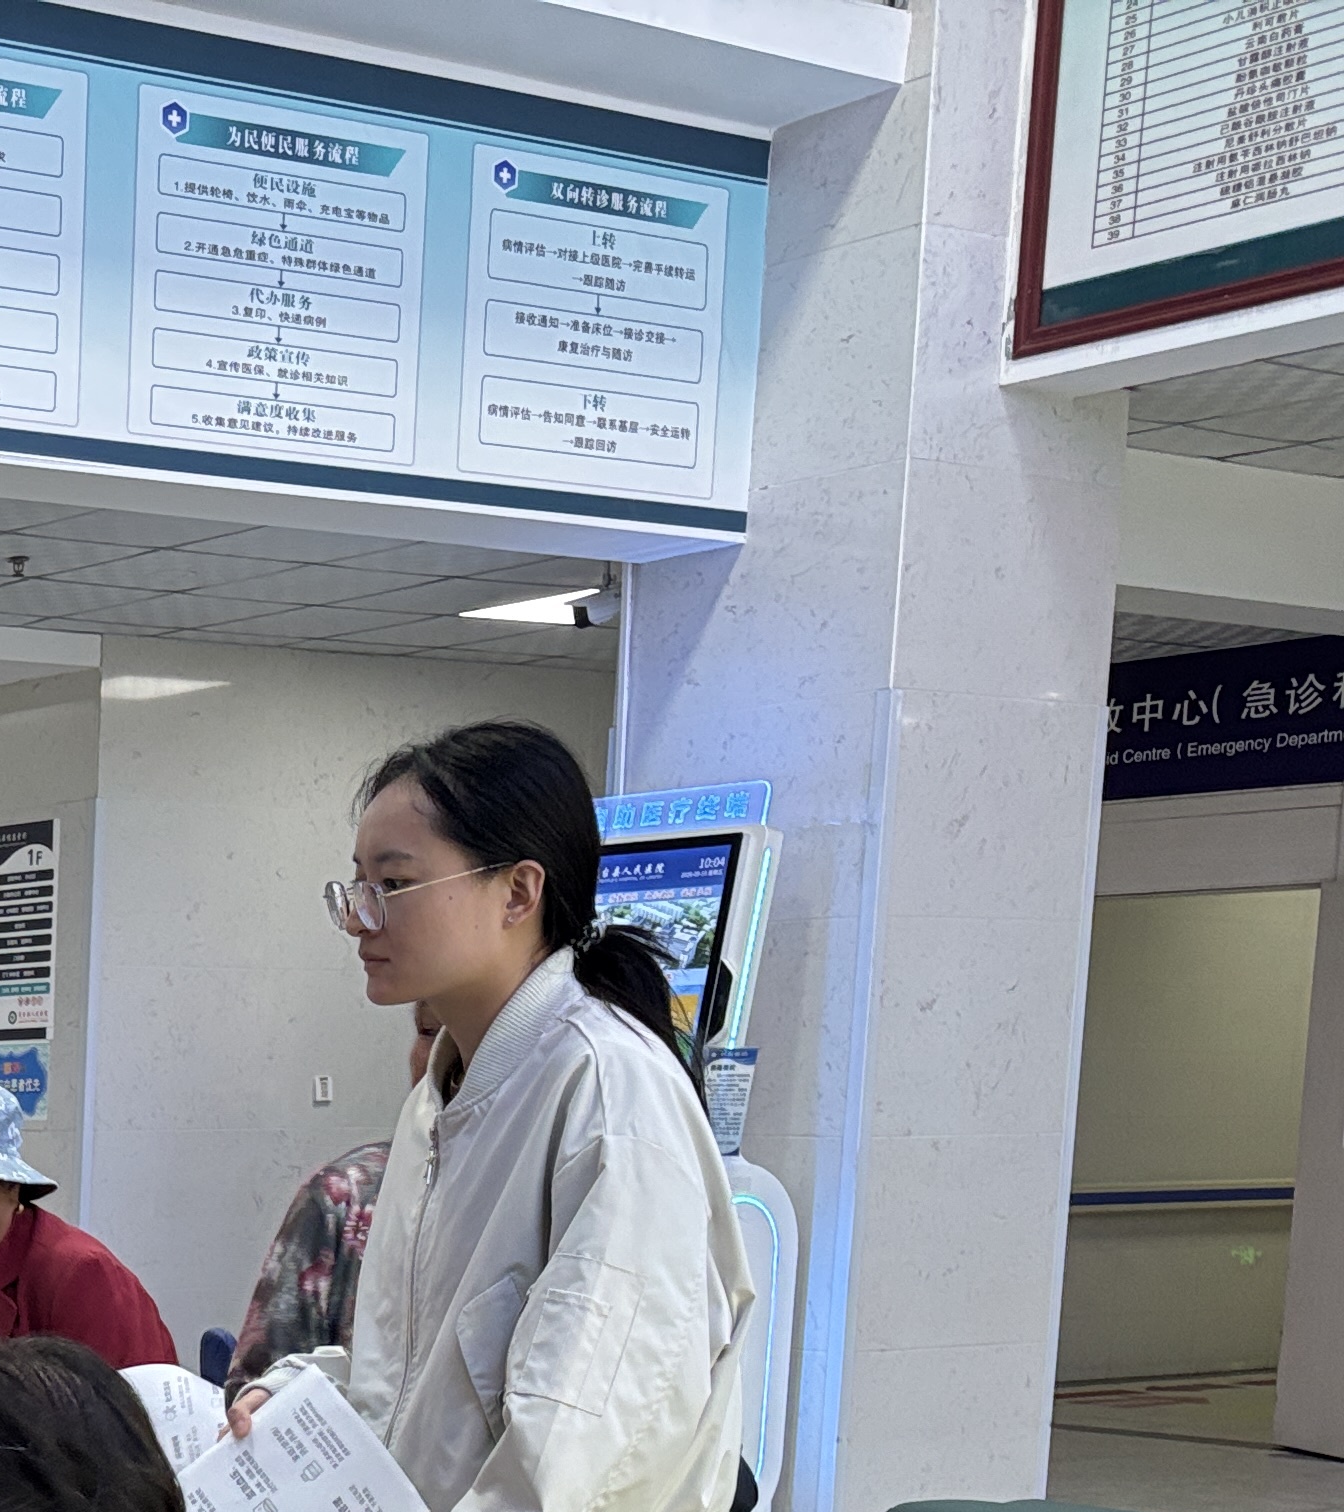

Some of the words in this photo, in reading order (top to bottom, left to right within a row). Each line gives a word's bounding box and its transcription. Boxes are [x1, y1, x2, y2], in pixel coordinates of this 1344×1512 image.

[1125, 13, 1138, 25] 25
[1123, 28, 1137, 40] 26
[1122, 44, 1136, 56] 27
[1119, 75, 1133, 87] 29
[1118, 91, 1132, 102] 30
[1117, 106, 1130, 117] 31
[1116, 121, 1129, 133] 32
[226, 126, 360, 167] 为民便民服务流程
[1115, 137, 1128, 149] 33
[1113, 153, 1126, 164] 34
[1112, 168, 1125, 179] 35
[1111, 183, 1124, 195] 36
[1110, 199, 1123, 210] 37
[1107, 229, 1120, 240] 39
[251, 231, 315, 254] 绿色通道
[249, 287, 313, 311] 代办服务
[247, 345, 311, 368] 政策宣传
[1123, 748, 1171, 764] Centre
[1187, 736, 1272, 757] Emergency
[28, 849, 43, 866] 1F
